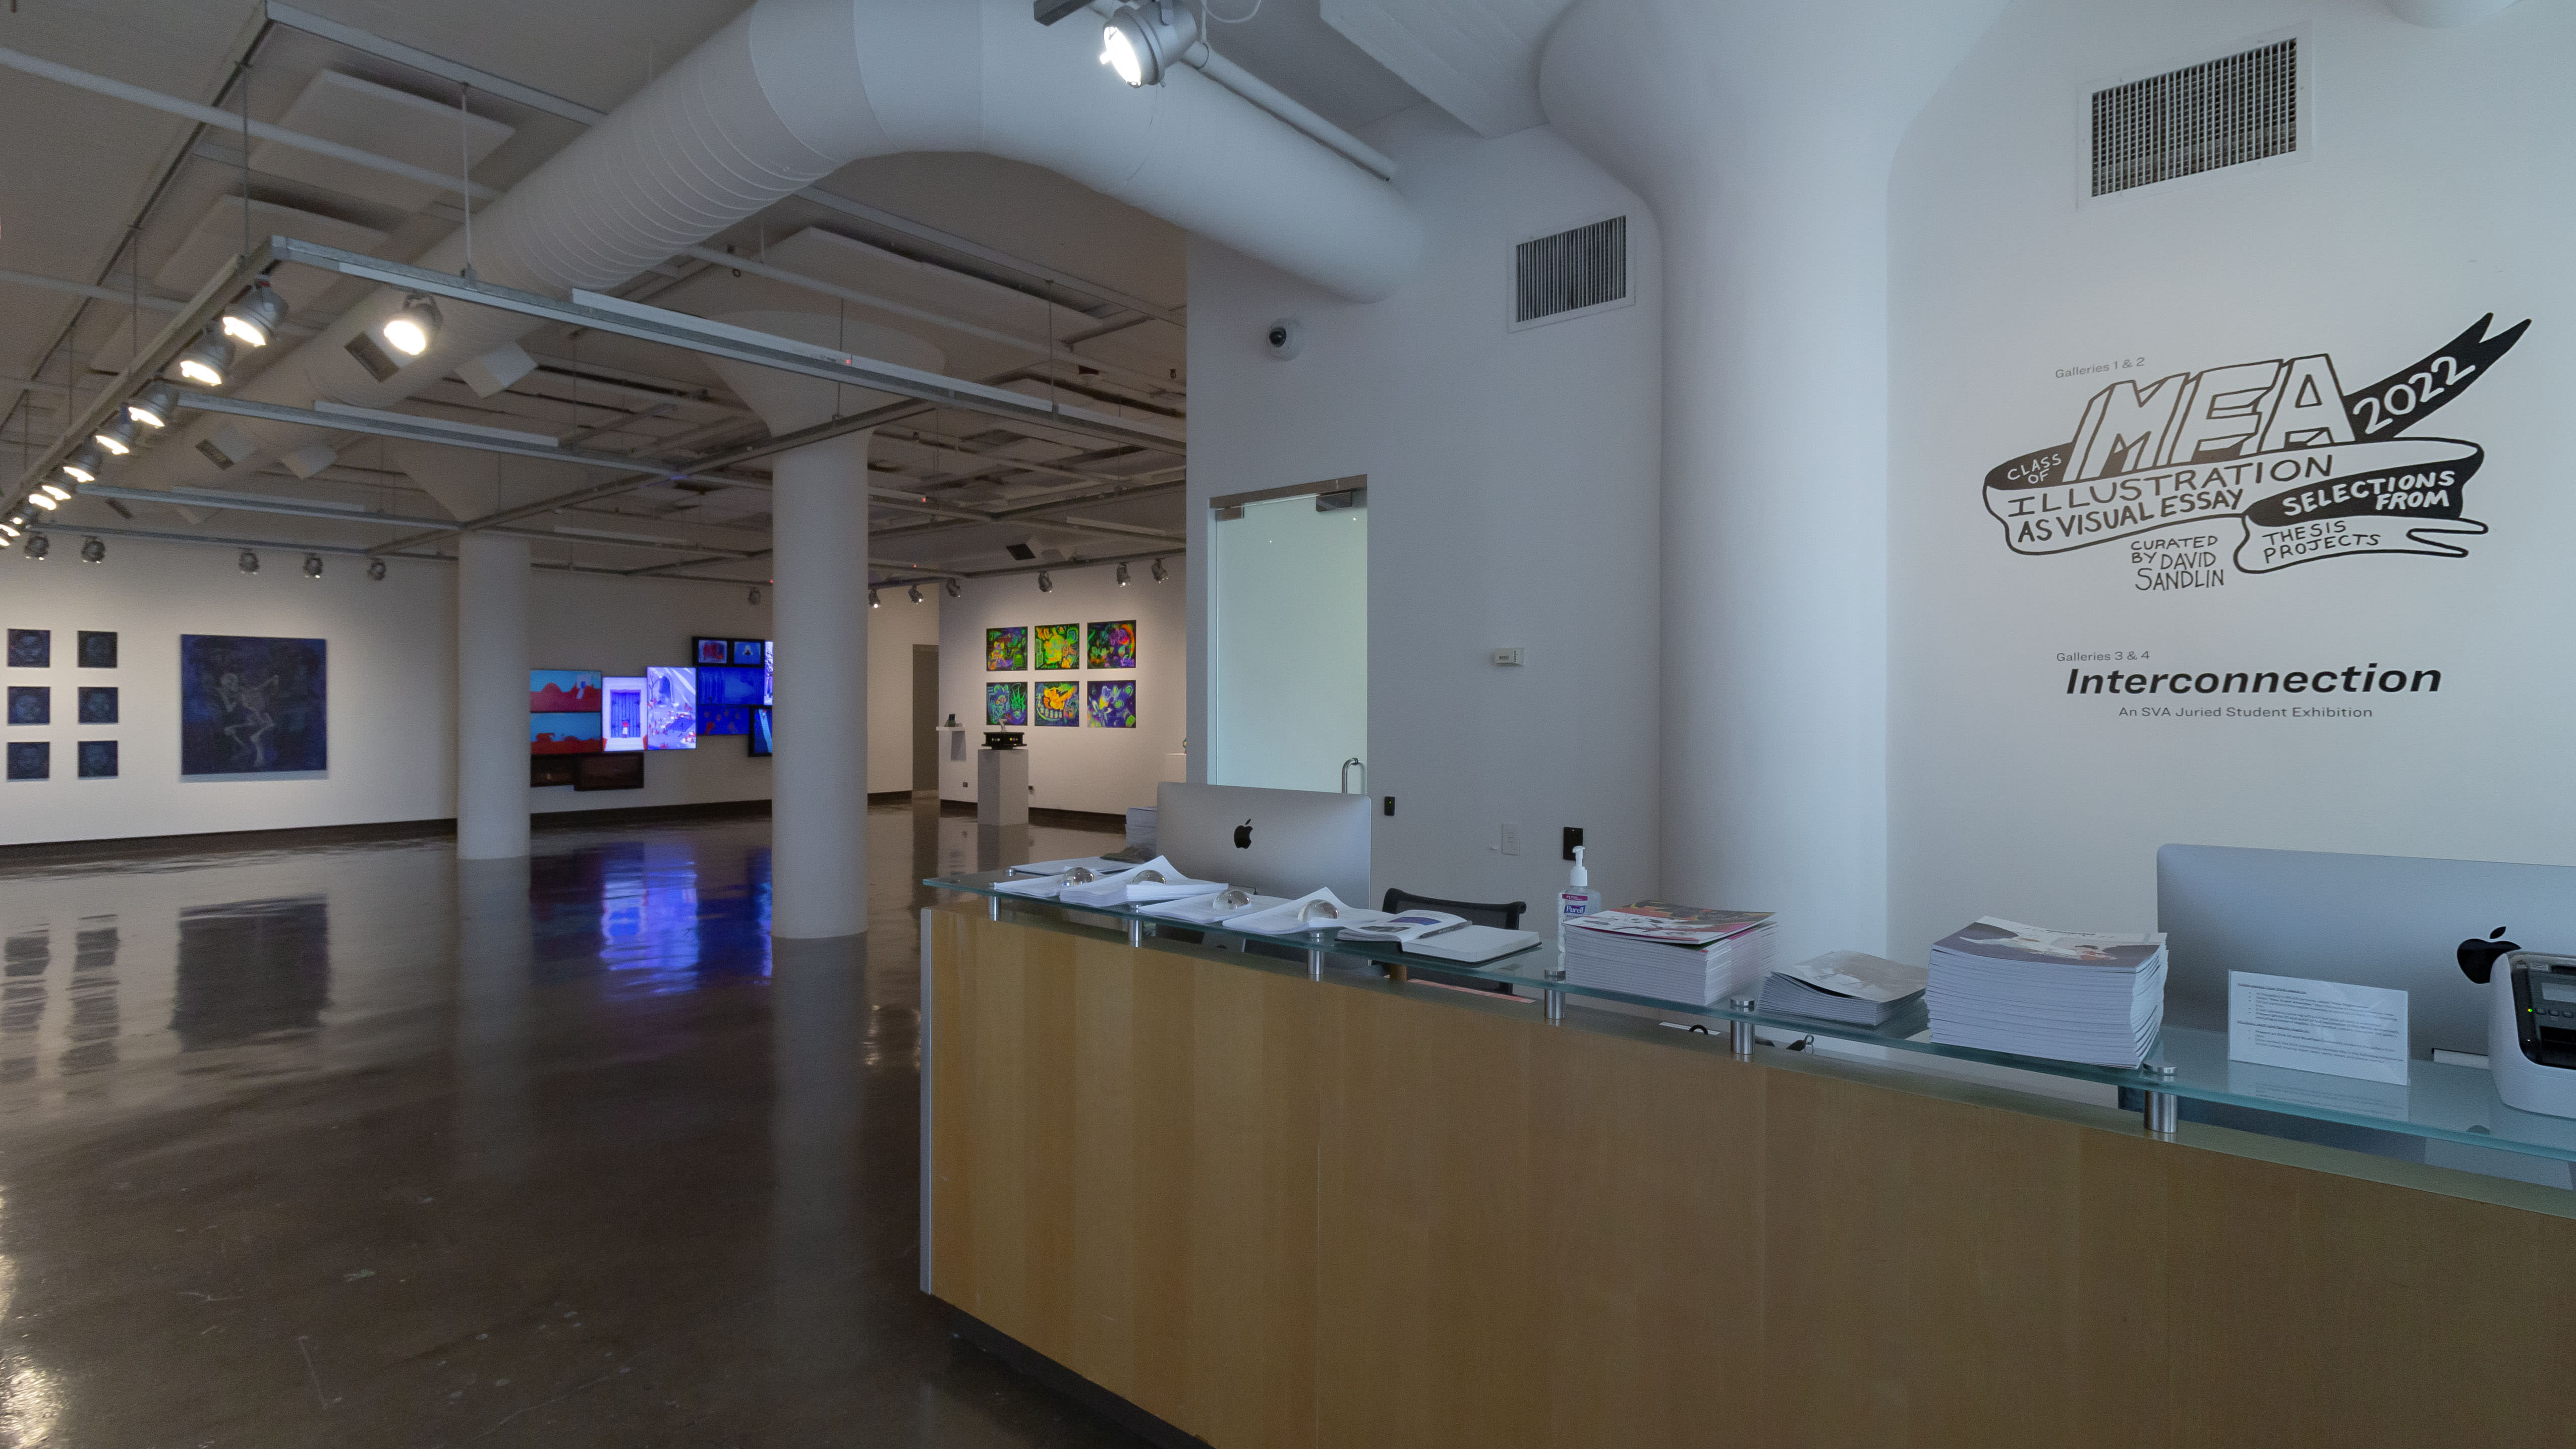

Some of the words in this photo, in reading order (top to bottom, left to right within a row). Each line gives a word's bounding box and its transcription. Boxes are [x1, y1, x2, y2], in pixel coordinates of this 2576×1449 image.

[2055, 364, 2110, 378] Galleries
[2113, 360, 2118, 370] 1
[2122, 359, 2133, 369] &
[2136, 357, 2145, 367] 2
[2353, 356, 2476, 434] 2022
[2063, 353, 2357, 483] MFA
[2007, 453, 2063, 482] CLASS
[2028, 469, 2050, 484] OF
[2008, 454, 2333, 517] ILLUSTRATION
[2282, 470, 2455, 516] SELECTIONS
[2375, 490, 2450, 511] FROM
[2018, 518, 2052, 543] AS
[2055, 502, 2154, 537] VISUAL
[2160, 488, 2243, 517] ESSAY
[2131, 535, 2218, 551] CURATED
[2262, 520, 2346, 545] THESIS
[2132, 551, 2157, 564] BY
[2160, 551, 2216, 570] DAVID
[2263, 534, 2381, 564] PROJECTS
[2135, 567, 2224, 592] SANDLIN
[2056, 652, 2111, 662] Galleries
[2114, 651, 2123, 661] 3
[2127, 651, 2138, 660] &
[2141, 651, 2150, 660] 4
[2066, 663, 2442, 695] Interconnection
[2119, 707, 2137, 717] An
[2142, 707, 2171, 717] SVA
[2176, 707, 2221, 717] Juried
[2226, 707, 2287, 717] Student
[2292, 707, 2373, 717] Exhibition
[1566, 905, 1584, 914] Purell
